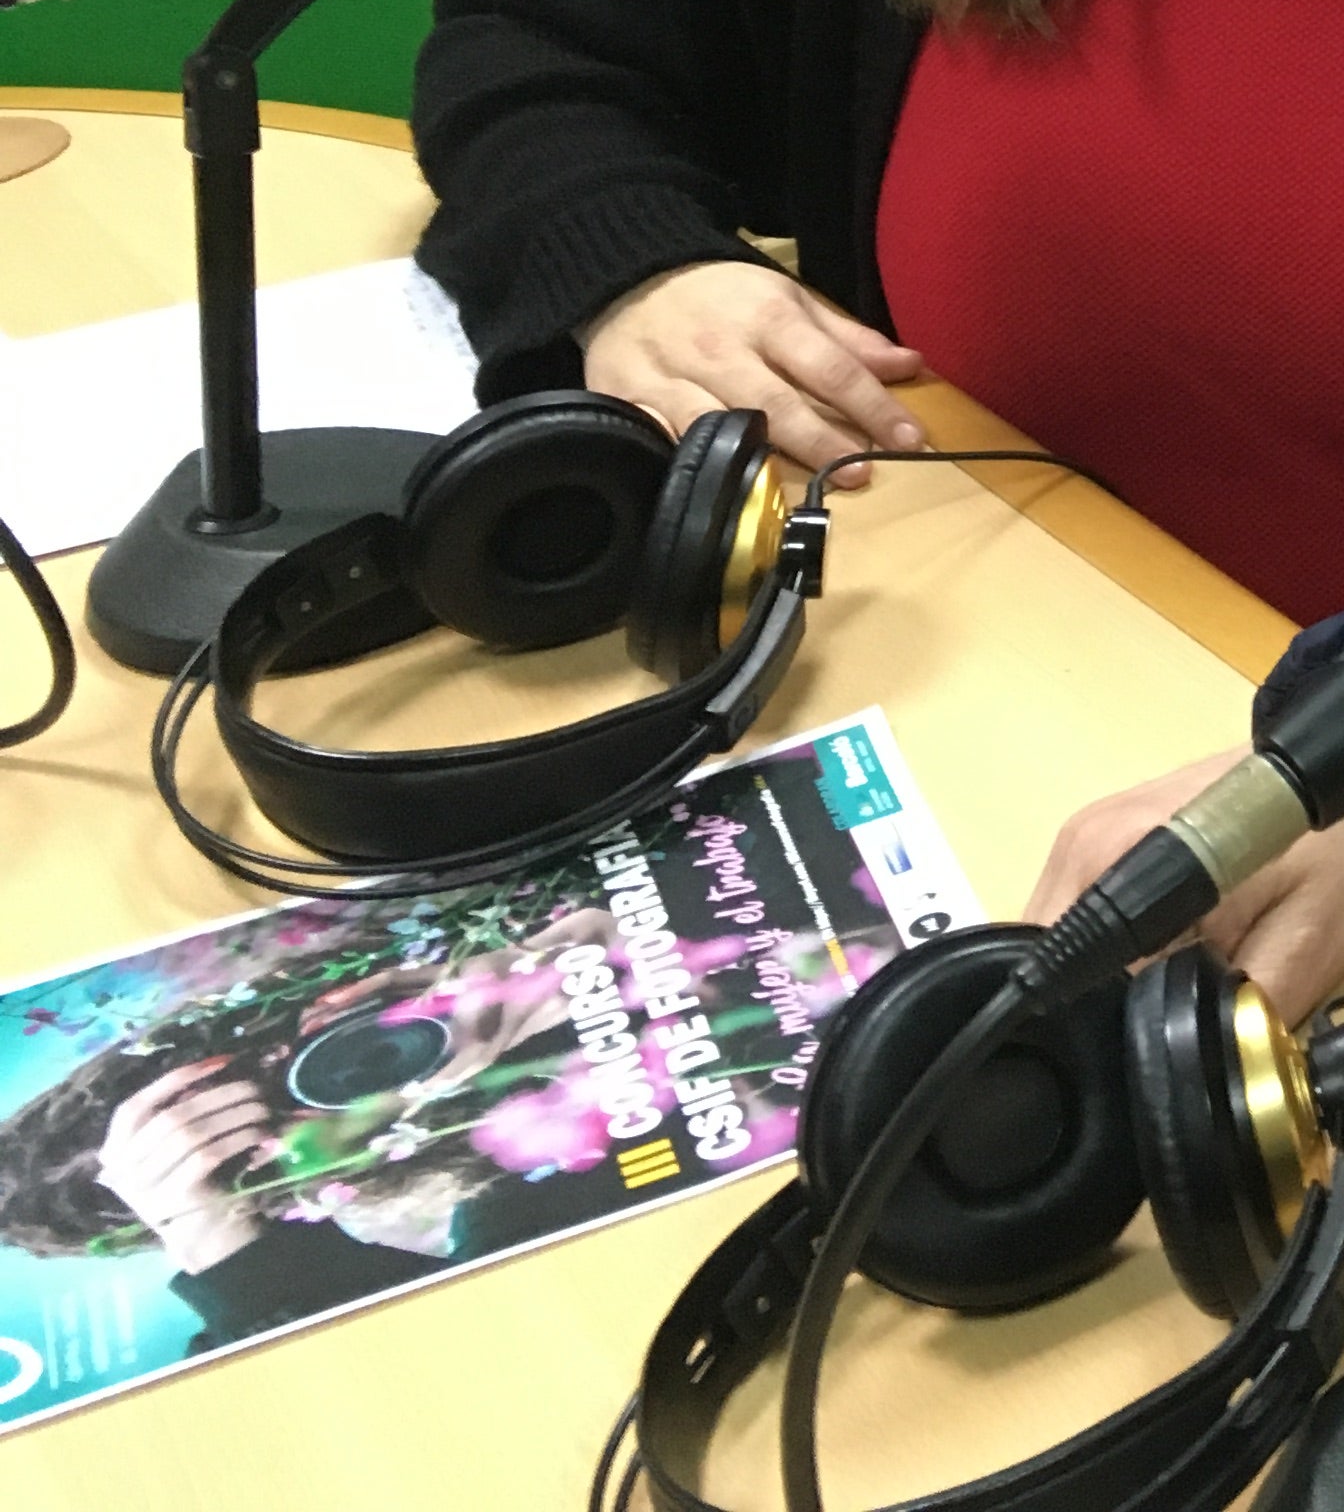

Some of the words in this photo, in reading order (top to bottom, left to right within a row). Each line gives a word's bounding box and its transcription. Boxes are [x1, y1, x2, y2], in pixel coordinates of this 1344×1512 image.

[713, 900, 765, 924] el
[554, 943, 663, 1140] CONCURSO
[652, 1013, 721, 1077] DE
[672, 1074, 752, 1161] CSIF
[615, 1138, 682, 1189] III
